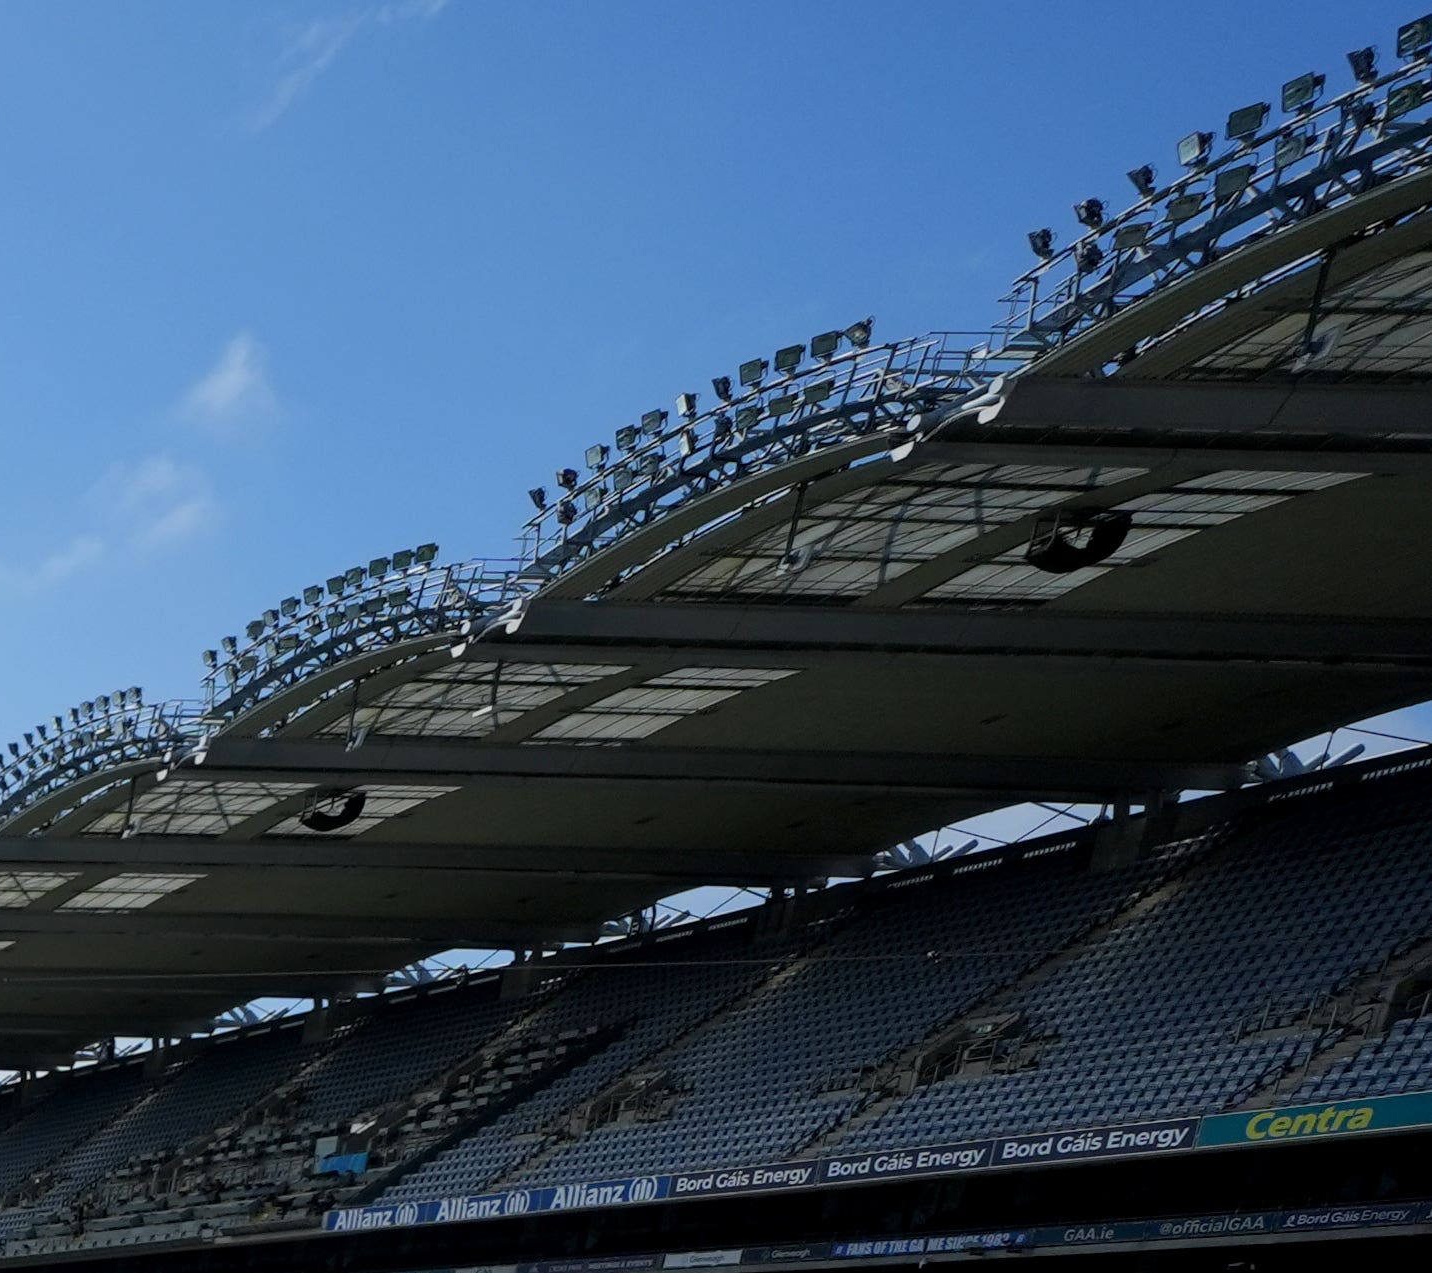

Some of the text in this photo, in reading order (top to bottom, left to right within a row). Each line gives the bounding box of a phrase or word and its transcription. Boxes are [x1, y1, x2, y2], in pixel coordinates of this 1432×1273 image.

[1245, 1106, 1374, 1141] Centra
[1002, 1125, 1189, 1159] Bord Gáis Energy
[828, 1147, 986, 1178] Bord Gáis Energy
[676, 1166, 812, 1193] Bord Gáis Energy
[550, 1183, 624, 1210] Allianz
[334, 1208, 392, 1232] Allianz
[435, 1197, 502, 1223] Allianz
[1297, 1213, 1330, 1226] Bord
[1361, 1209, 1410, 1222] Energy
[1064, 1226, 1114, 1242] GAA.ie
[1159, 1216, 1265, 1236] @officialGAA
[846, 1242, 873, 1256] FANS
